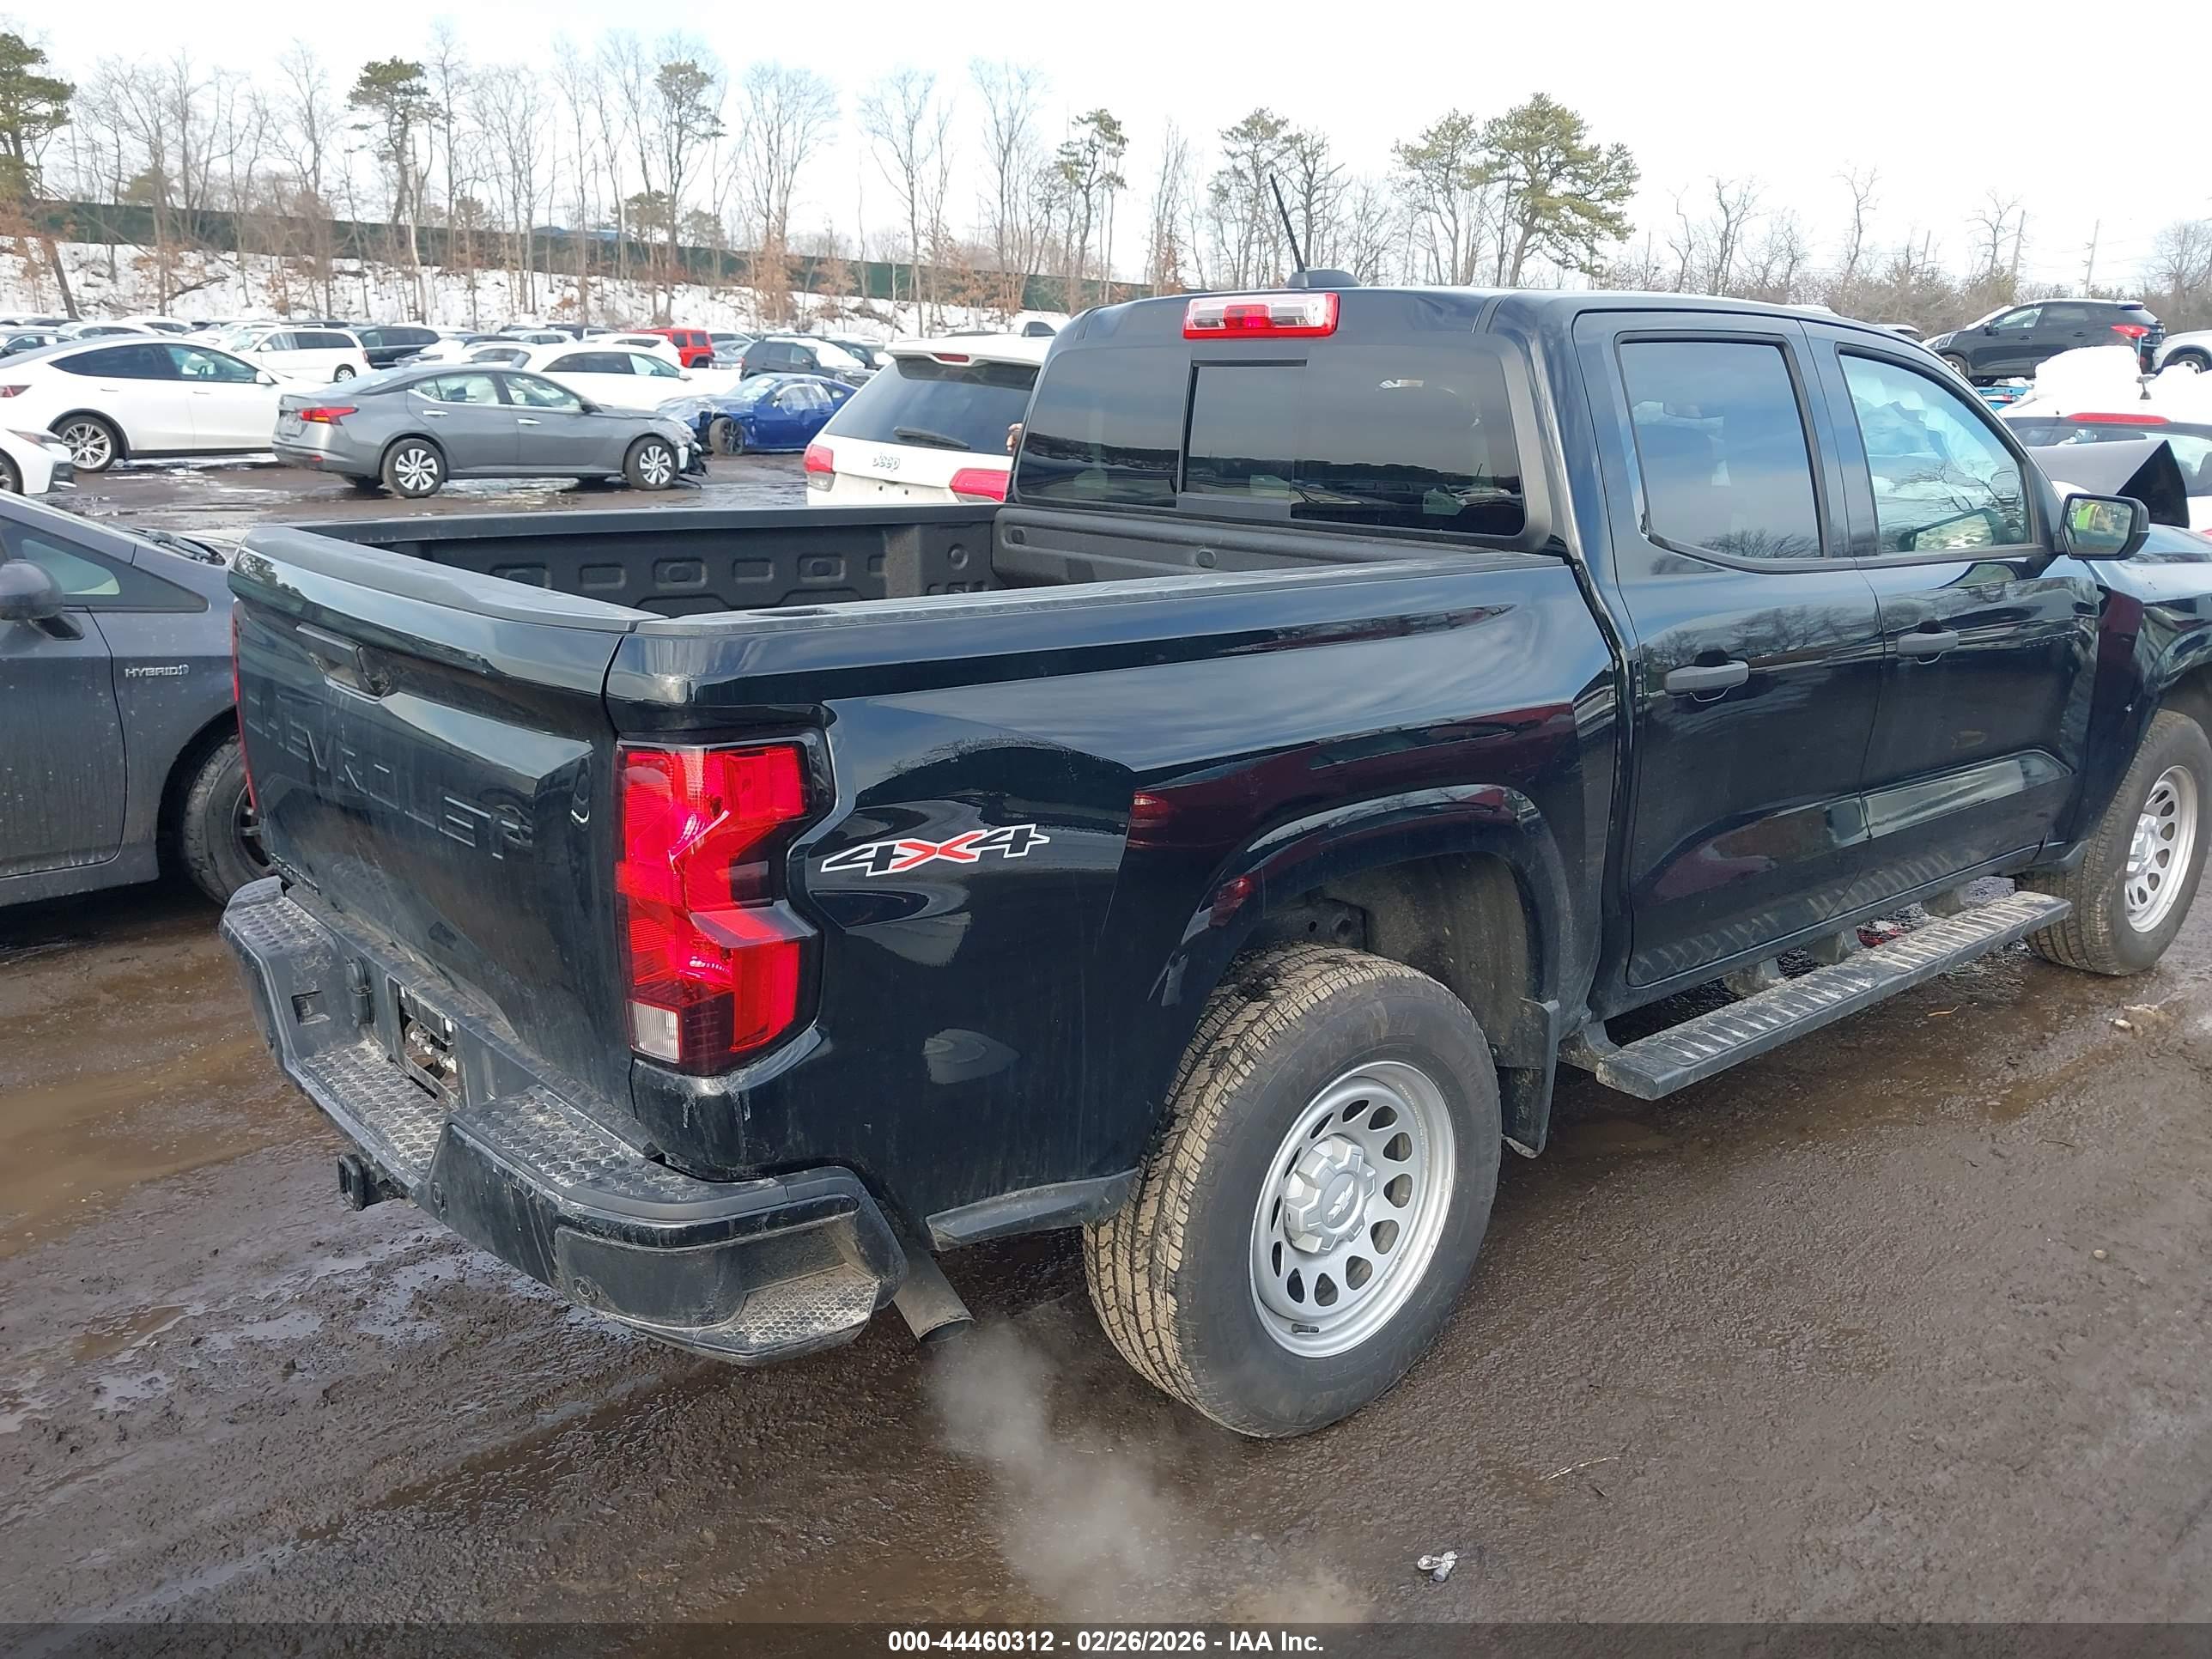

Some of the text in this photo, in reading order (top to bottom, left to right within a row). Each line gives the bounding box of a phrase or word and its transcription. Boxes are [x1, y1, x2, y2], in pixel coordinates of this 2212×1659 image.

[872, 453, 901, 472] Jeep
[125, 665, 179, 678] HYBRID
[245, 692, 520, 861] CHEVROLET
